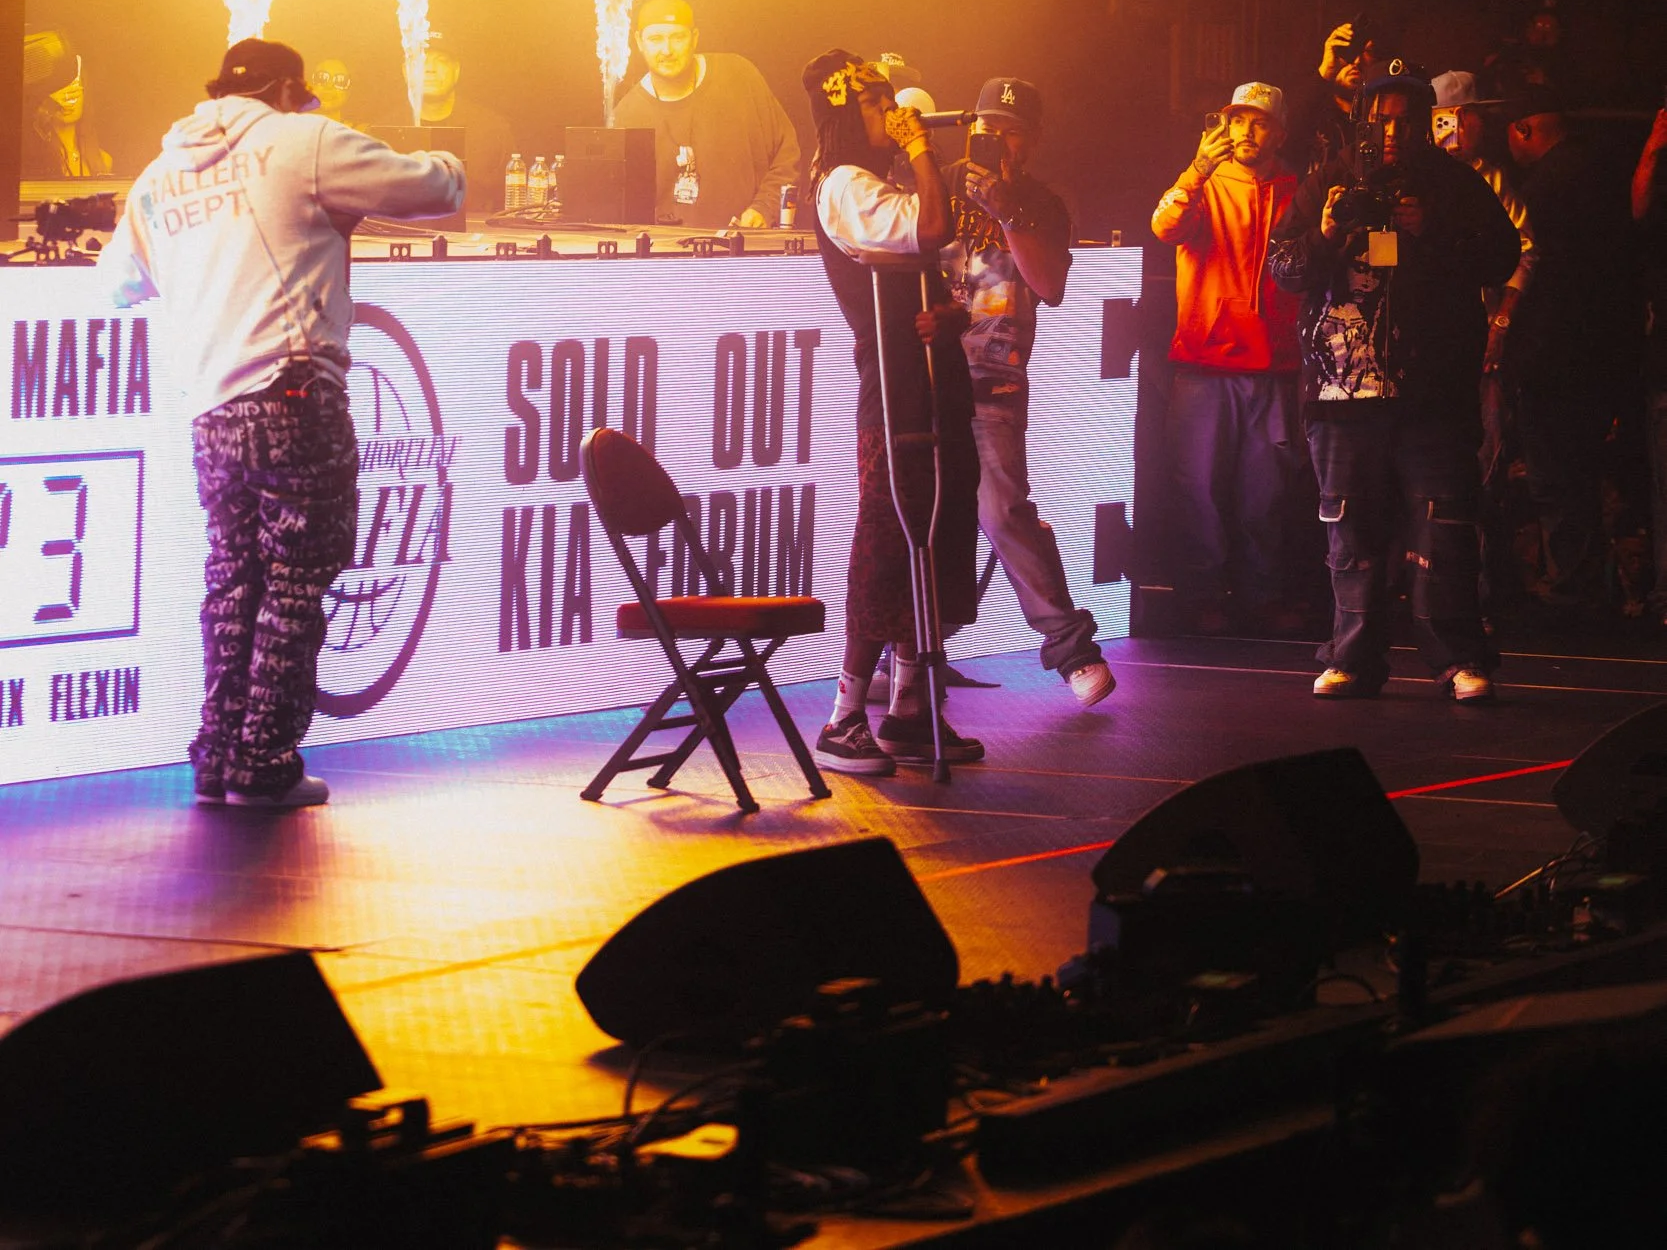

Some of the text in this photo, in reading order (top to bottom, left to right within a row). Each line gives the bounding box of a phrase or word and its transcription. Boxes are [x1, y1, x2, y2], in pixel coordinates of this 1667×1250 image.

[1000, 83, 1016, 105] LA
[11, 317, 151, 420] MAFIA
[504, 328, 821, 486] SOLD OUT
[358, 434, 463, 481] HORELINE
[343, 481, 453, 569] FIA
[498, 502, 593, 654] KIA
[50, 665, 141, 723] FLEXIN
